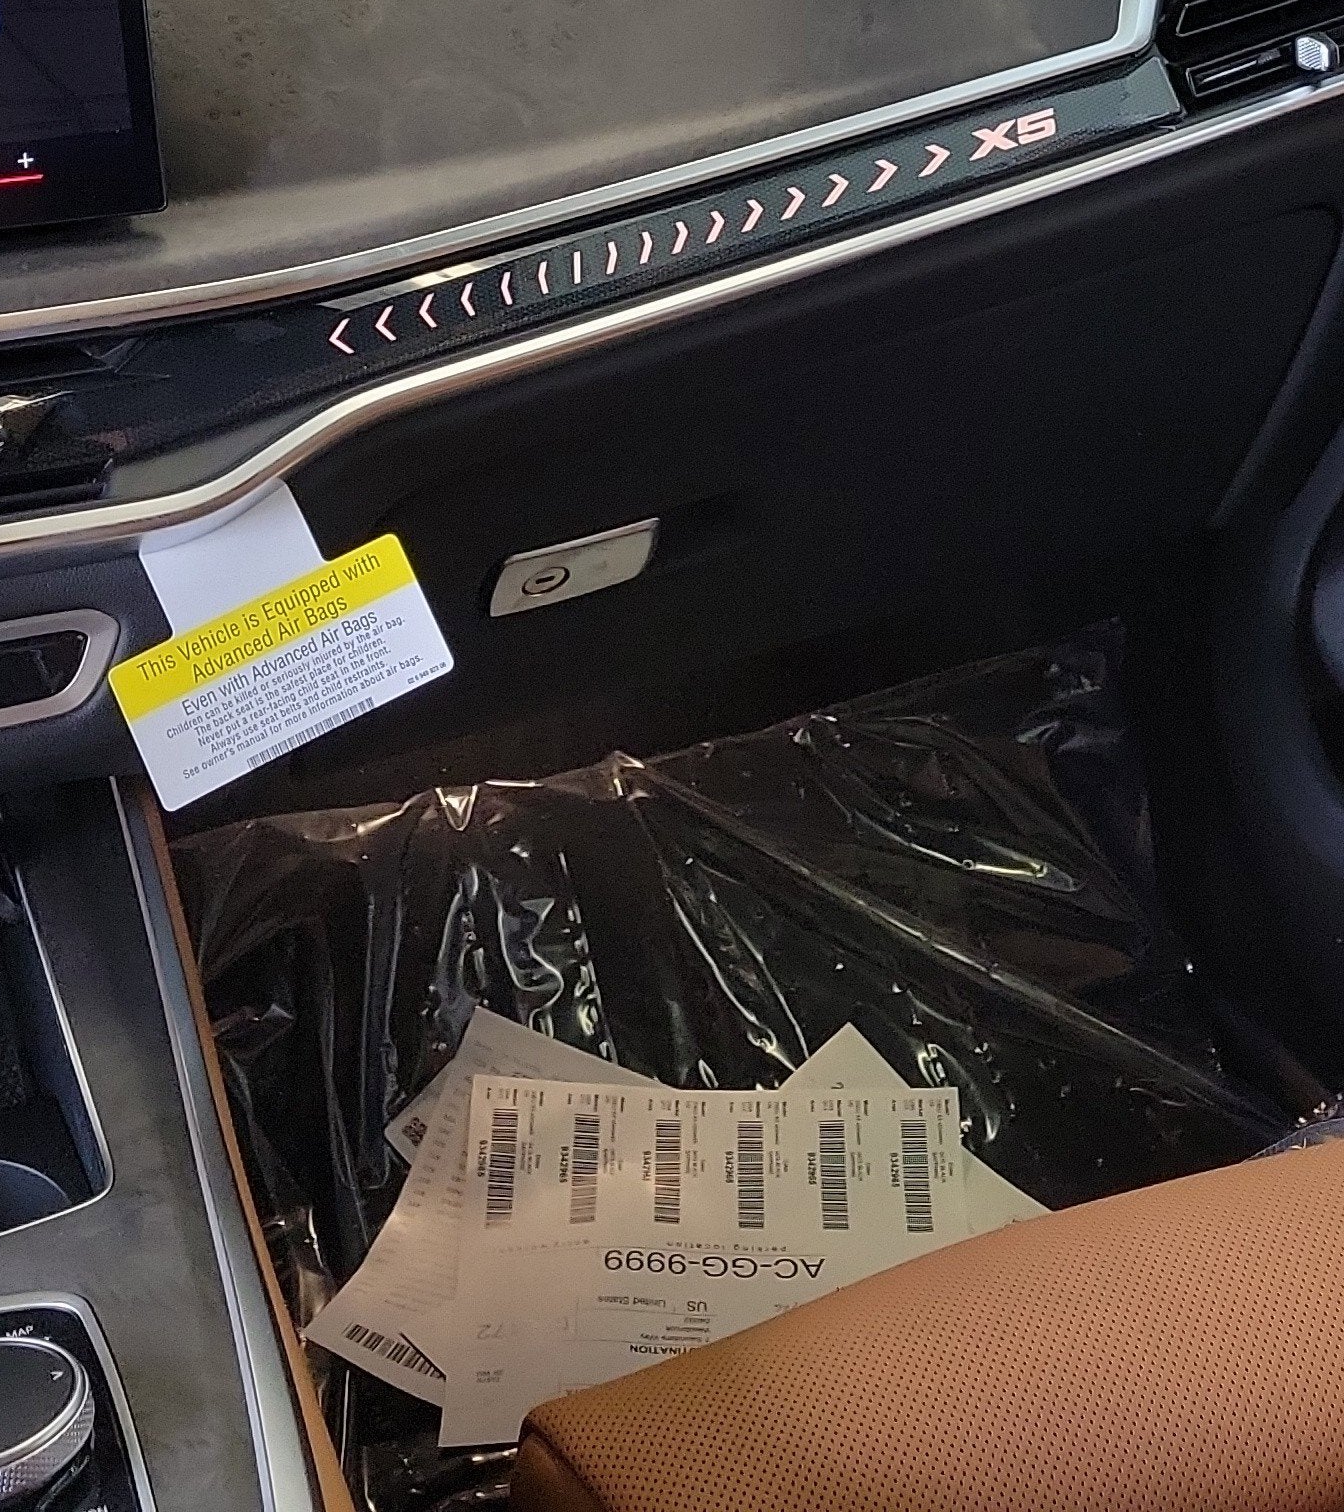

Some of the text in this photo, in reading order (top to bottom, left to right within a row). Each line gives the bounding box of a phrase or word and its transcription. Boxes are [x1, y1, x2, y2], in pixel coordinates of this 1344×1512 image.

[969, 107, 1057, 162] X5
[136, 553, 380, 680] This Vehicle is Equipped with
[181, 611, 377, 715] Even with Advanced Air Bags
[193, 597, 347, 682] Advanced Air Bags
[166, 616, 404, 738] Children can be killed or seriously injured by the air bag.
[182, 655, 423, 778] See owner's manual for more information about air bags.
[193, 637, 385, 735] The back seat is the safest place for children.
[197, 646, 391, 746] Never put a rear-facing child seat in the front.
[210, 660, 387, 753] Always use seat belts and child restraints.
[605, 1249, 826, 1279] AC-GG-9999
[687, 1300, 708, 1312] US
[5, 1324, 35, 1339] MAP
